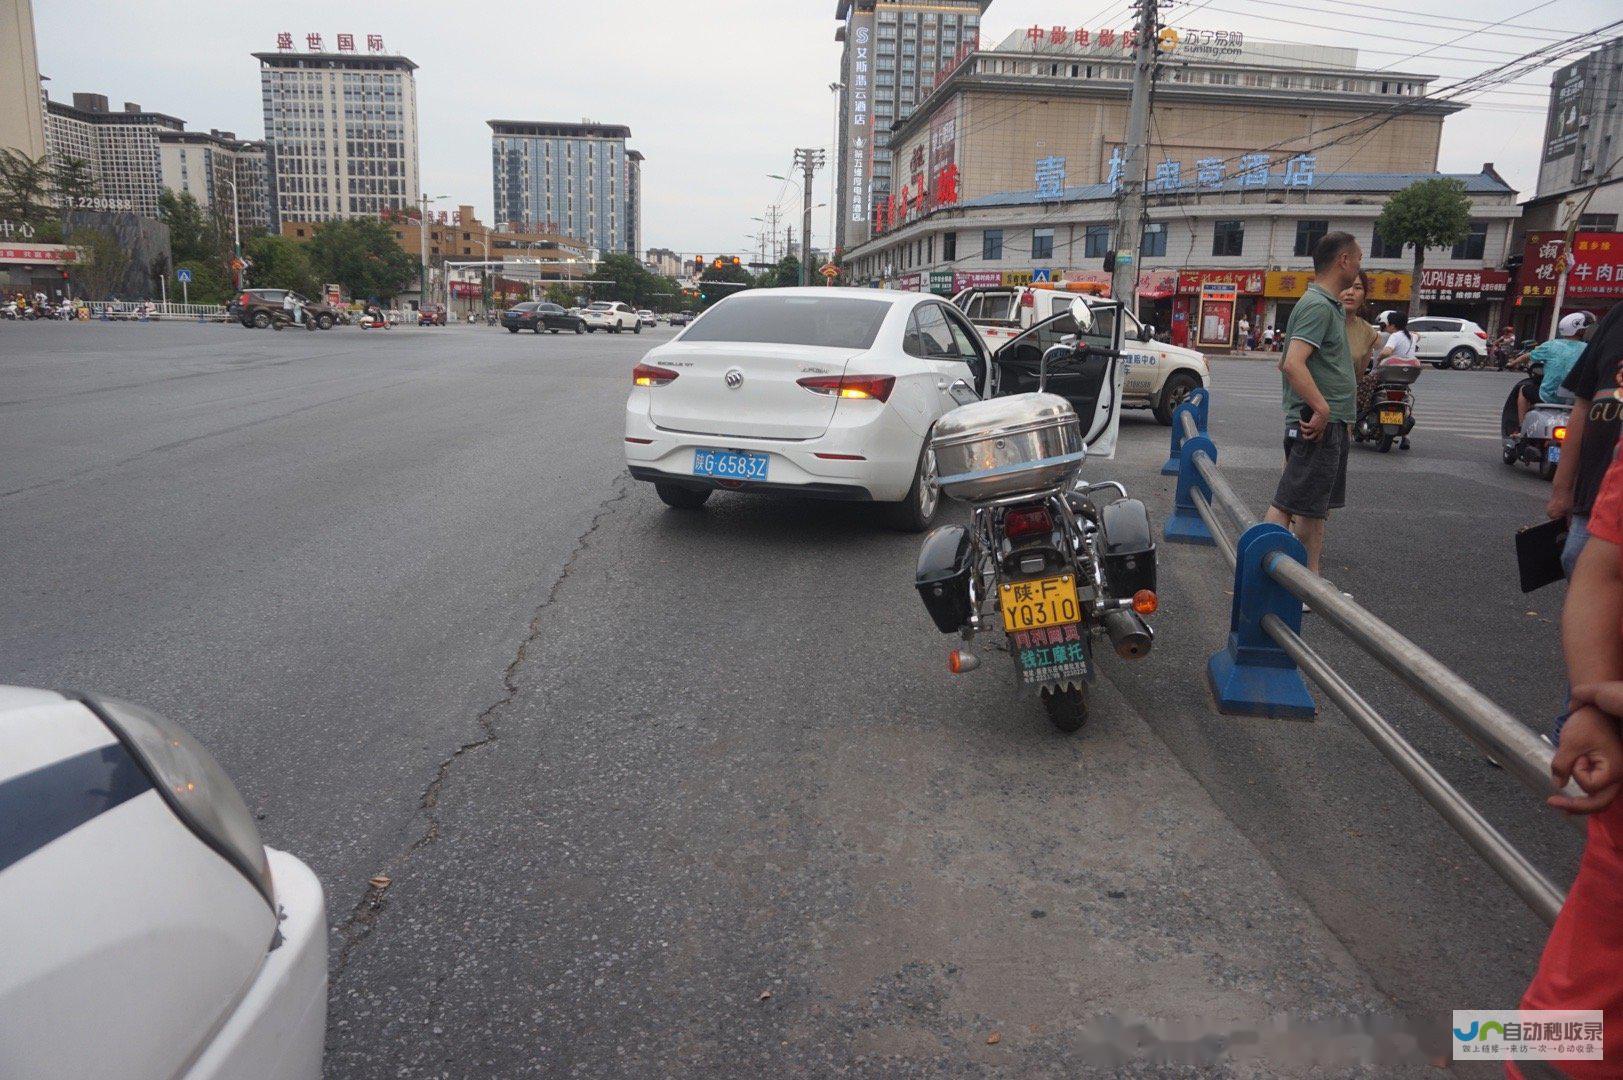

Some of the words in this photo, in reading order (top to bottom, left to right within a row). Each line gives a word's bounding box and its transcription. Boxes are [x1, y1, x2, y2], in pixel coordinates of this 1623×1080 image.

[277, 32, 384, 51] 盛世国际
[1026, 24, 1140, 49] 中影电影院
[1184, 28, 1243, 47] 苏宁易购
[1184, 45, 1242, 56] suning.com
[1589, 402, 1623, 421] GU
[1007, 598, 1075, 628] YQ310
